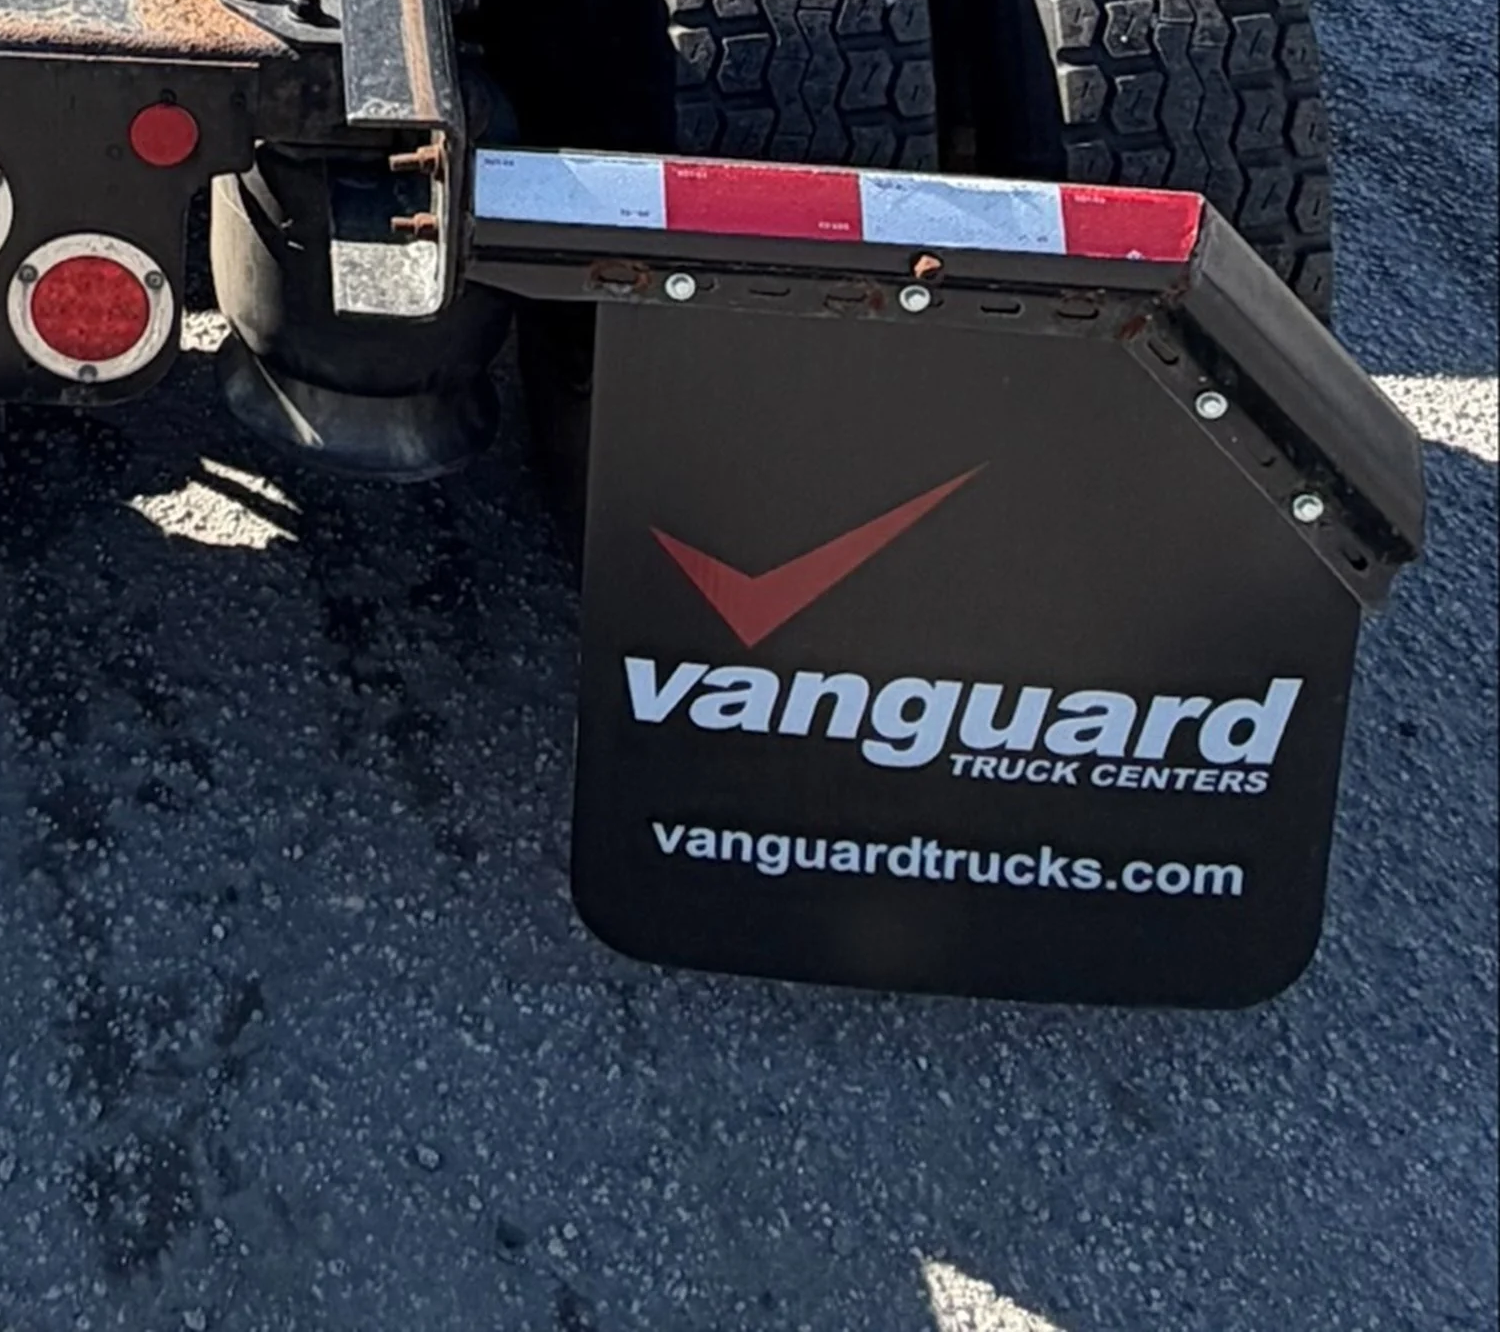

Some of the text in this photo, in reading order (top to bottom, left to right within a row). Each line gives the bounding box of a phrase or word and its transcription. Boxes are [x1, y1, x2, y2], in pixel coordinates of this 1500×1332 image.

[624, 656, 1304, 767] vanguard
[950, 753, 1269, 794] TRUCK CENTERS
[653, 822, 1244, 896] vanguardtrucks.com
